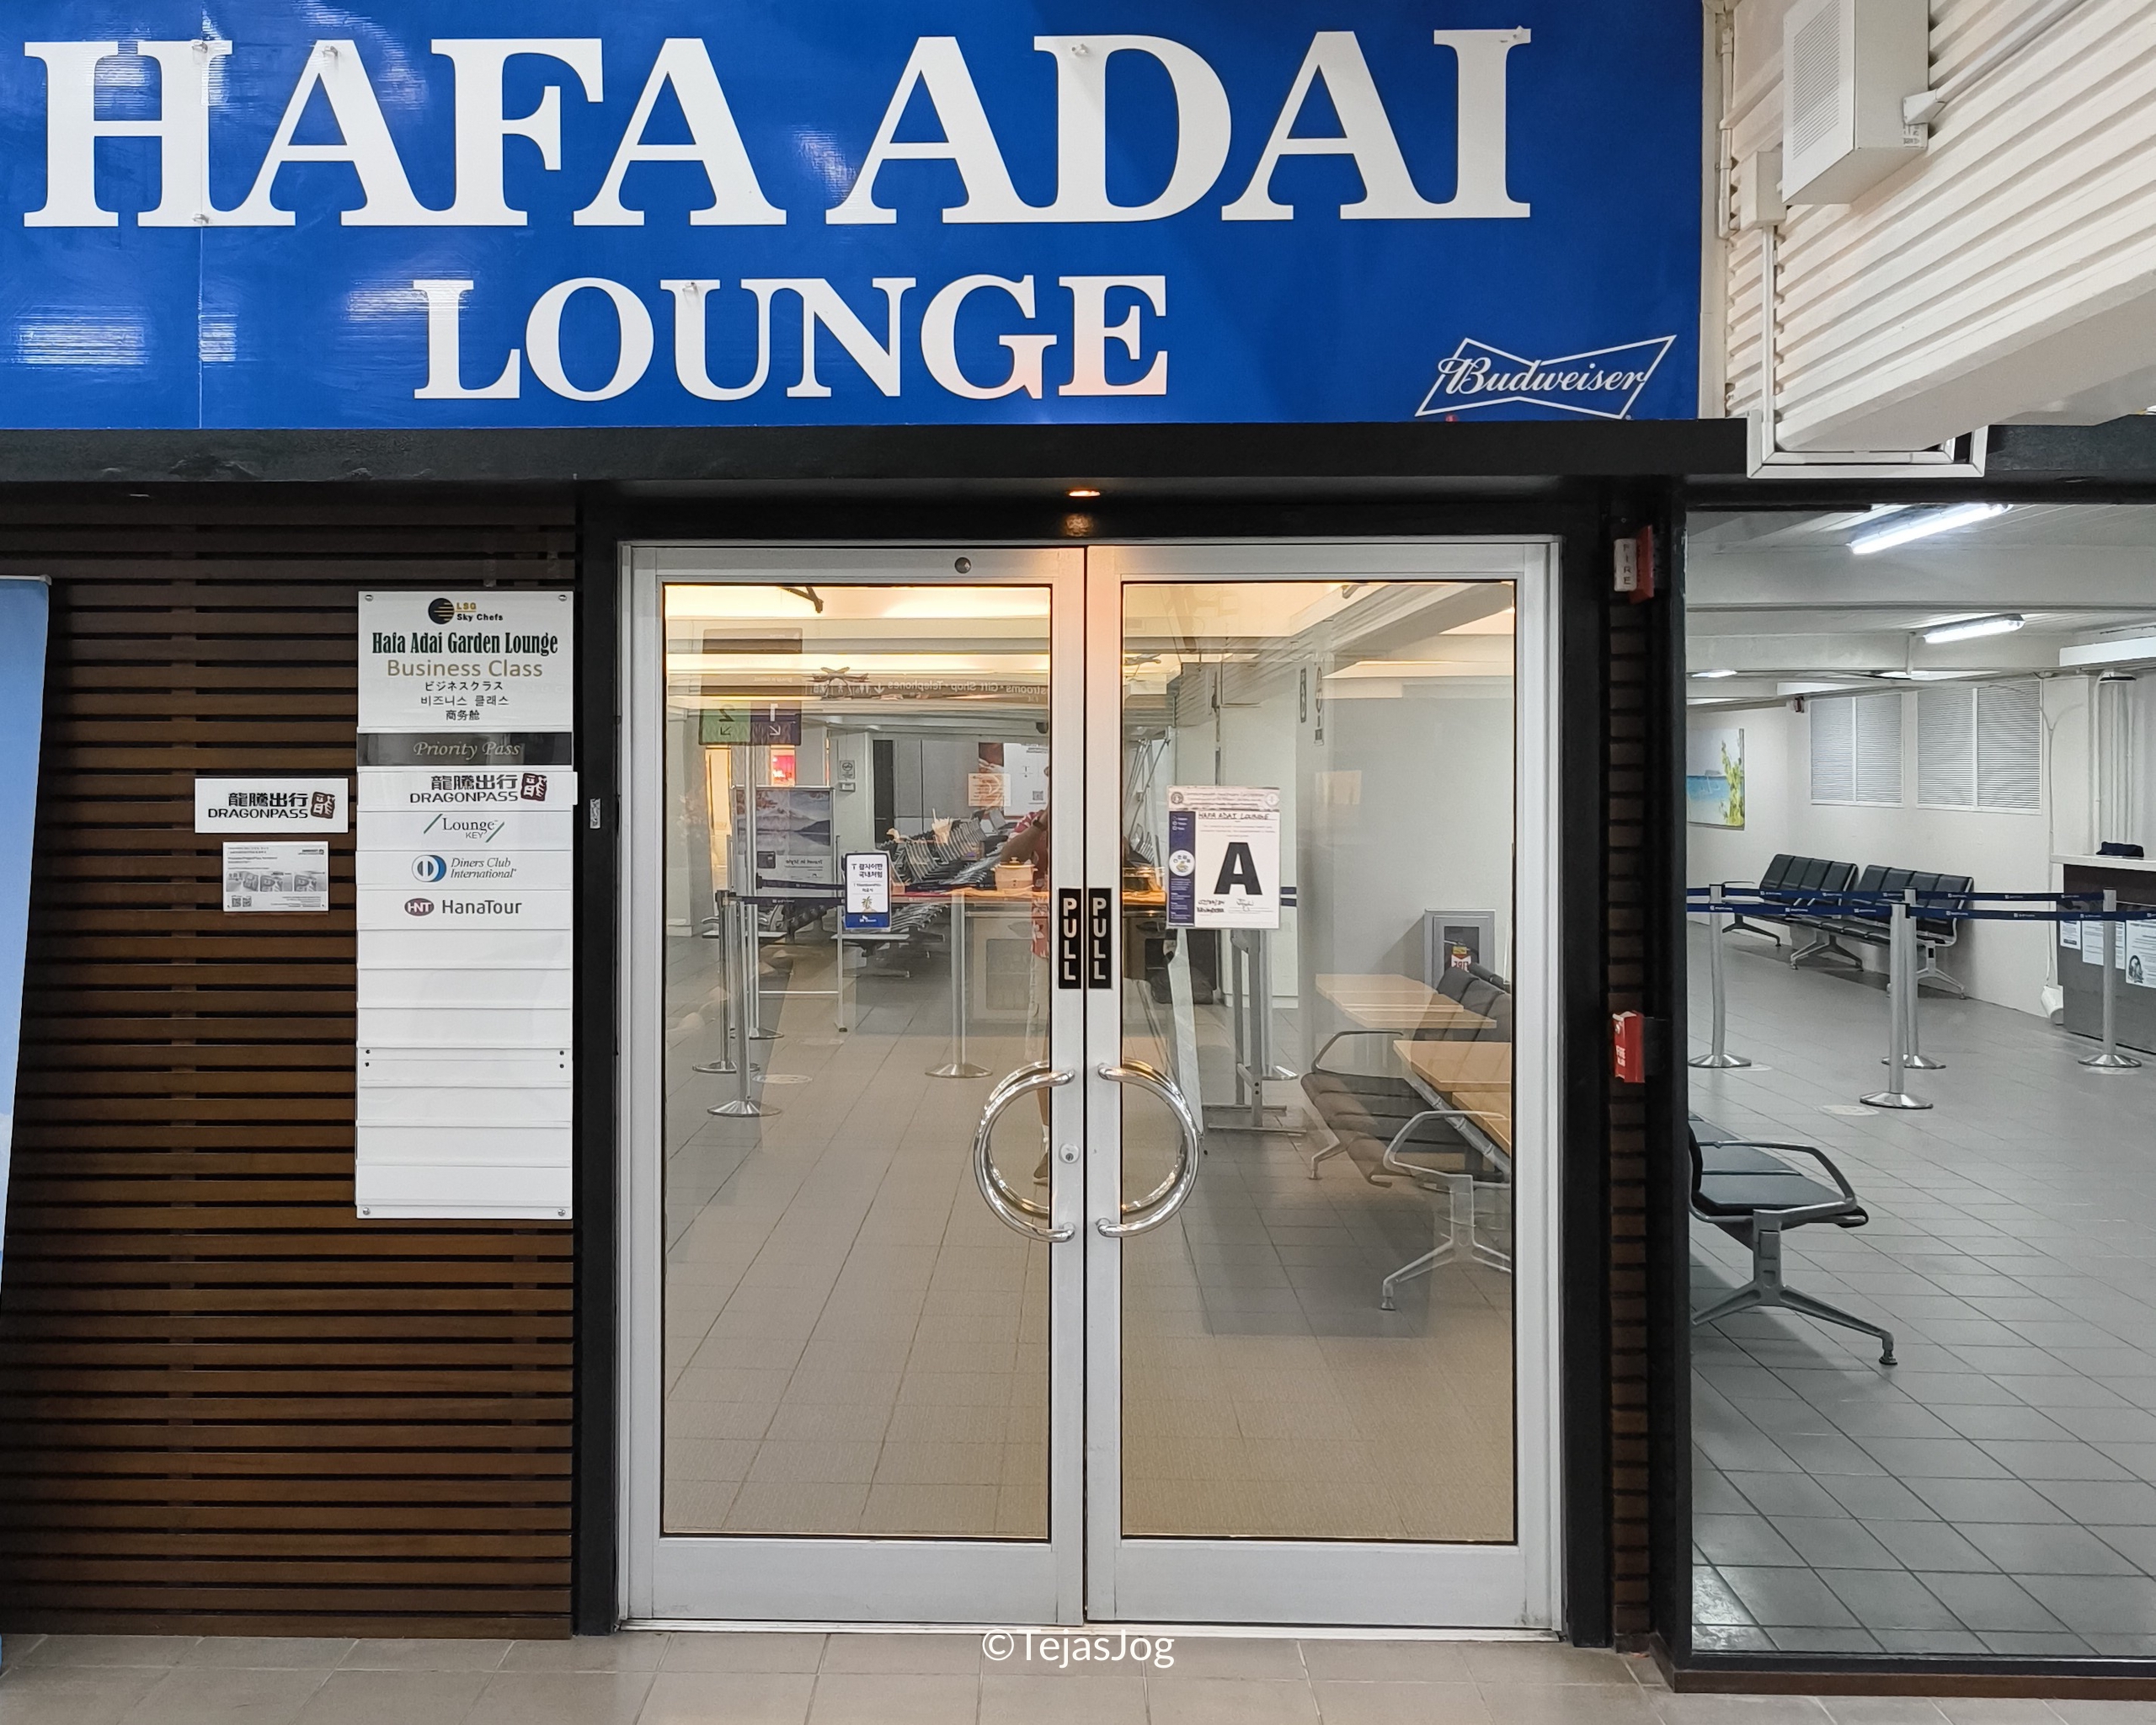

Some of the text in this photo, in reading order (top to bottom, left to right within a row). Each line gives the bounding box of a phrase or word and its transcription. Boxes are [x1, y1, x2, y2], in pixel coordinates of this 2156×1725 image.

[24, 29, 1531, 228] HAFA ADAI
[413, 275, 1168, 402] LOUNGE
[1438, 356, 1647, 394] Budweiser
[1622, 543, 1631, 585] FIRE
[456, 613, 473, 622] Sky
[372, 632, 558, 656] Hafa Adai Garden Lounge
[387, 660, 543, 677] Business Class
[425, 681, 504, 692] ビジネスクラス
[421, 695, 510, 706] 비즈니스 클래스
[446, 709, 481, 720] 商务舱
[413, 741, 520, 760] Priority Pass
[431, 774, 518, 790] 龍騰出行
[228, 792, 308, 807] 龍騰出行
[409, 792, 519, 804] DRAGONPASS
[208, 809, 308, 819] DRAGONPASS
[442, 818, 495, 834] Lounge
[451, 857, 511, 868] Diners Club
[1214, 841, 1262, 895] A
[407, 900, 522, 915] HNT HanaTour
[1063, 897, 1077, 980] PULL
[1092, 897, 1107, 980] PULL
